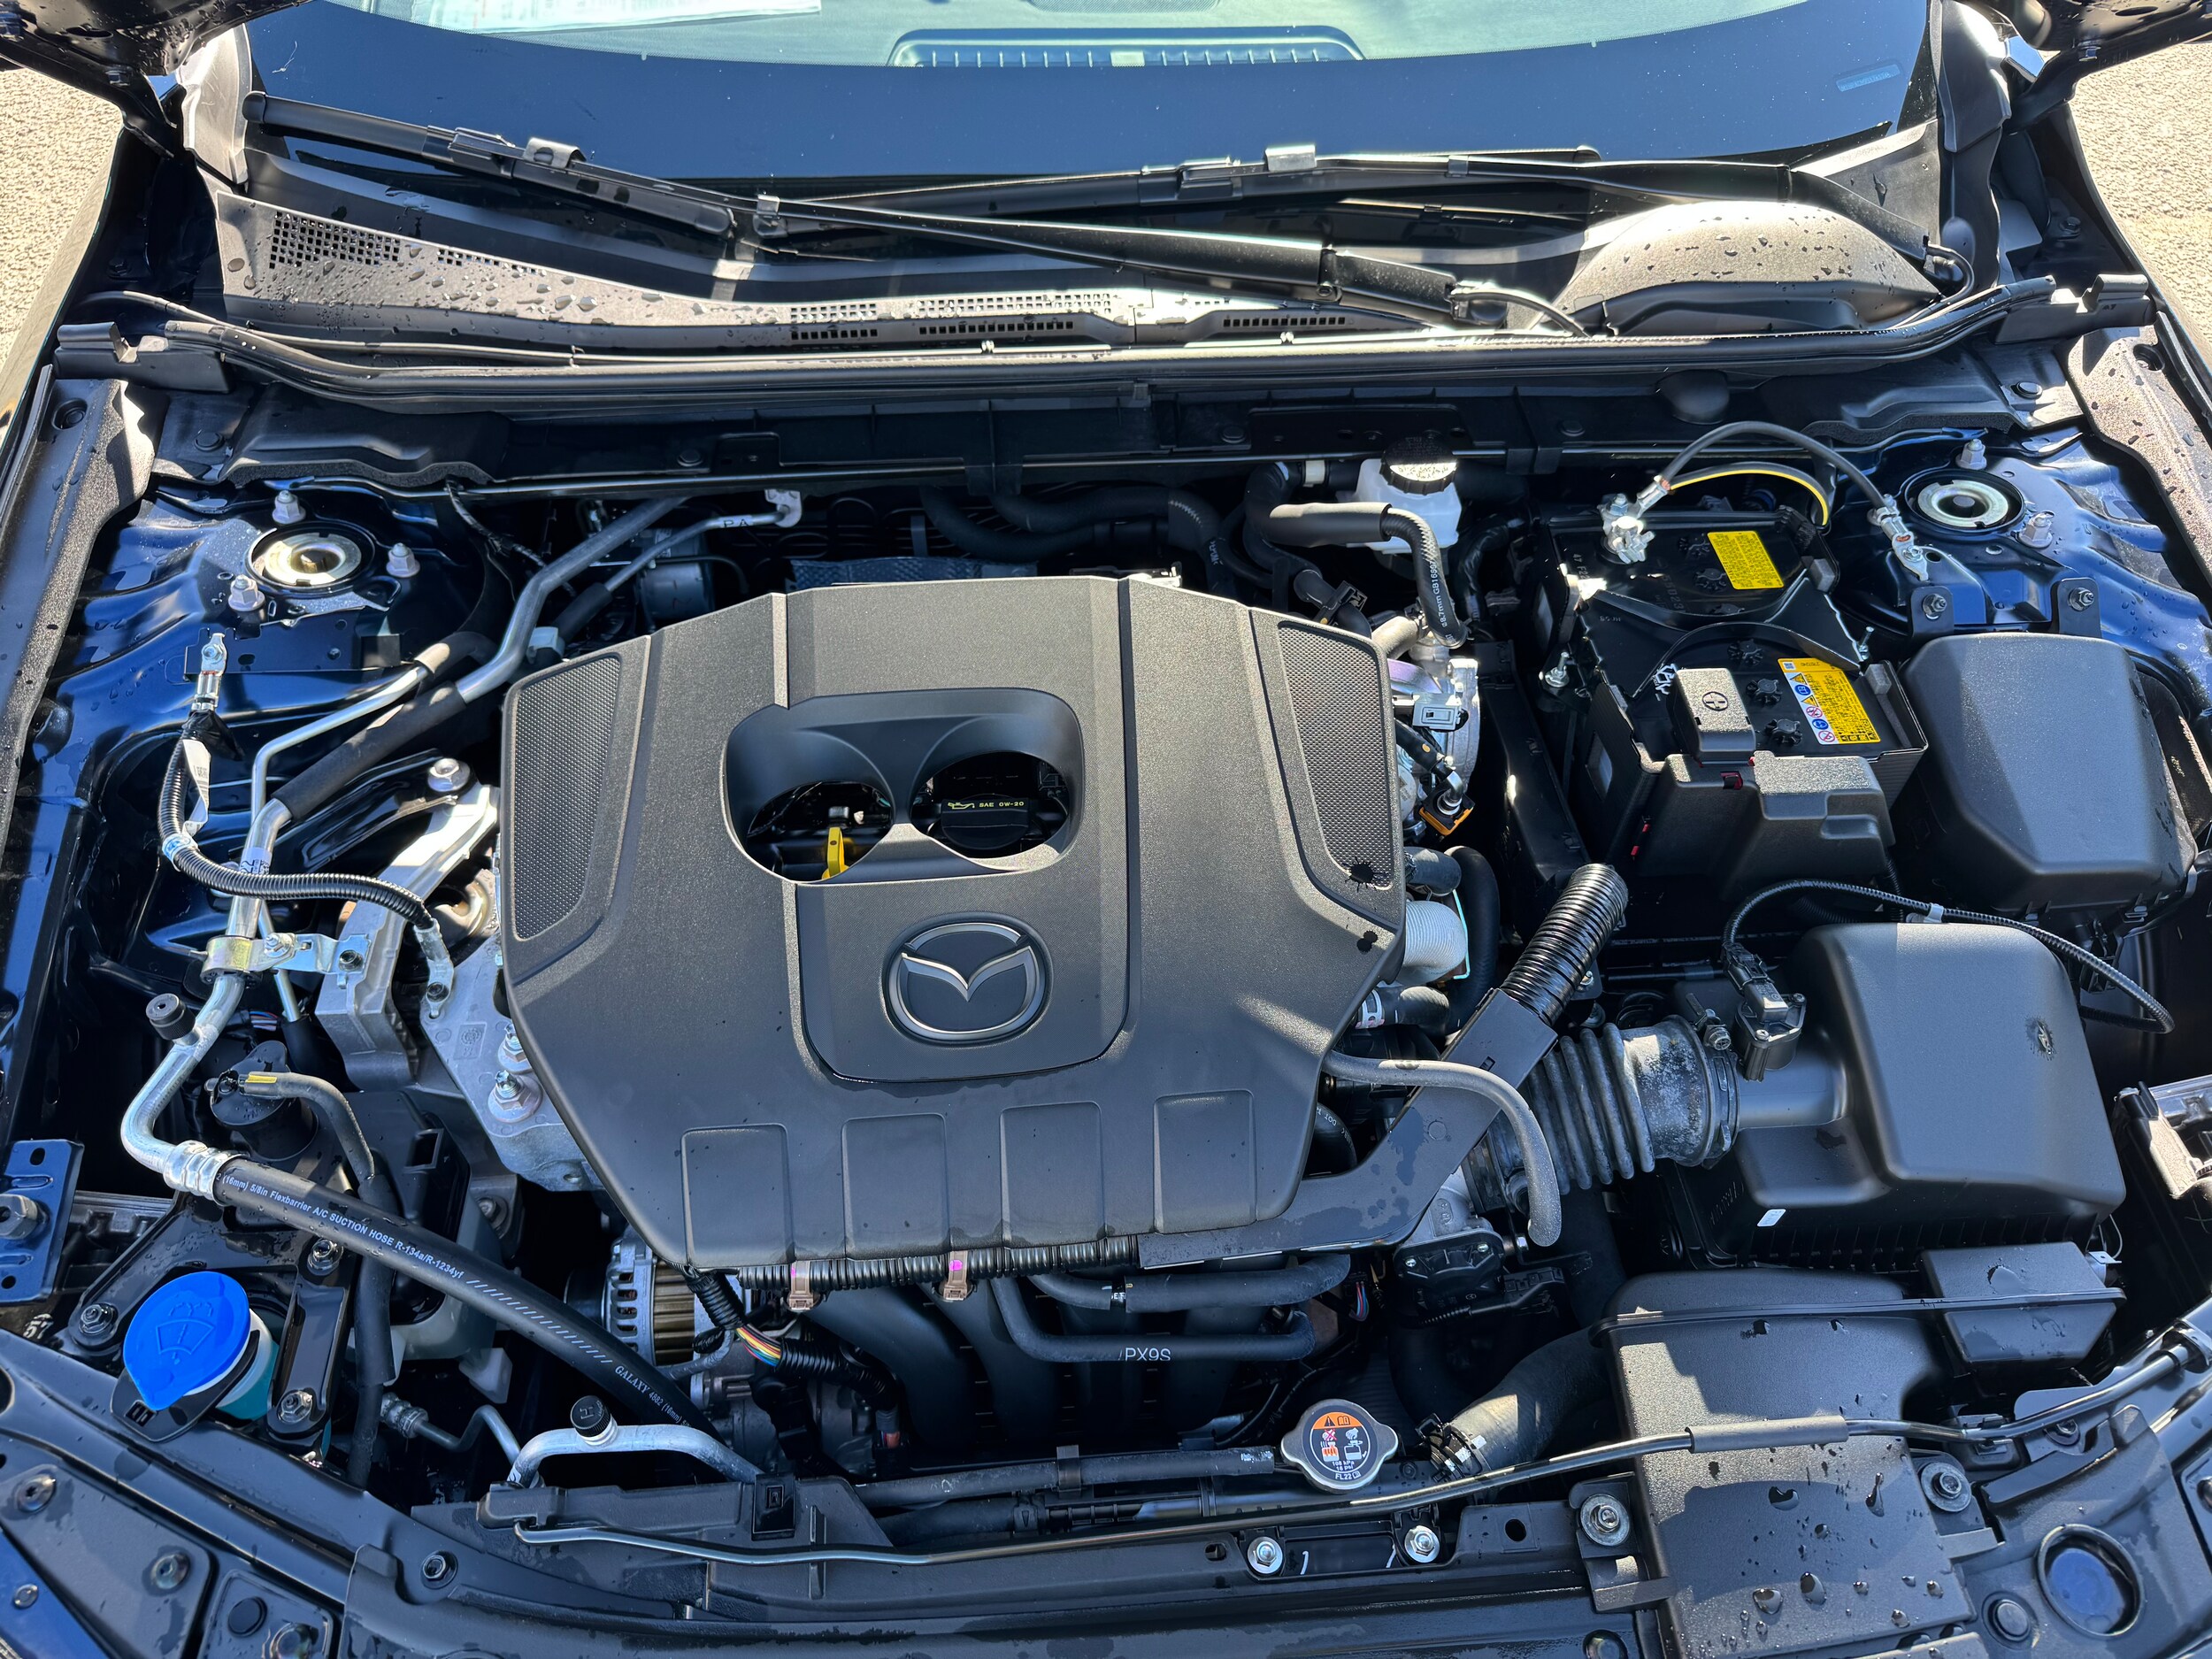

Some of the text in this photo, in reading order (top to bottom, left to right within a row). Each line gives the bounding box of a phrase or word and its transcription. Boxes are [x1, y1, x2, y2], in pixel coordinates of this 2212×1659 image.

[222, 1174, 250, 1191] (16mm)
[250, 1183, 268, 1197] 5/8in
[269, 1190, 312, 1212] Flexbarrier
[312, 1207, 329, 1218] A/C
[329, 1213, 368, 1235] SUCTION
[368, 1229, 395, 1247] HOSE
[395, 1240, 465, 1279] R-134a/R-1234yf
[615, 1365, 650, 1394] GALAXY
[649, 1392, 664, 1405] 4882
[661, 1403, 682, 1424] (16mm)
